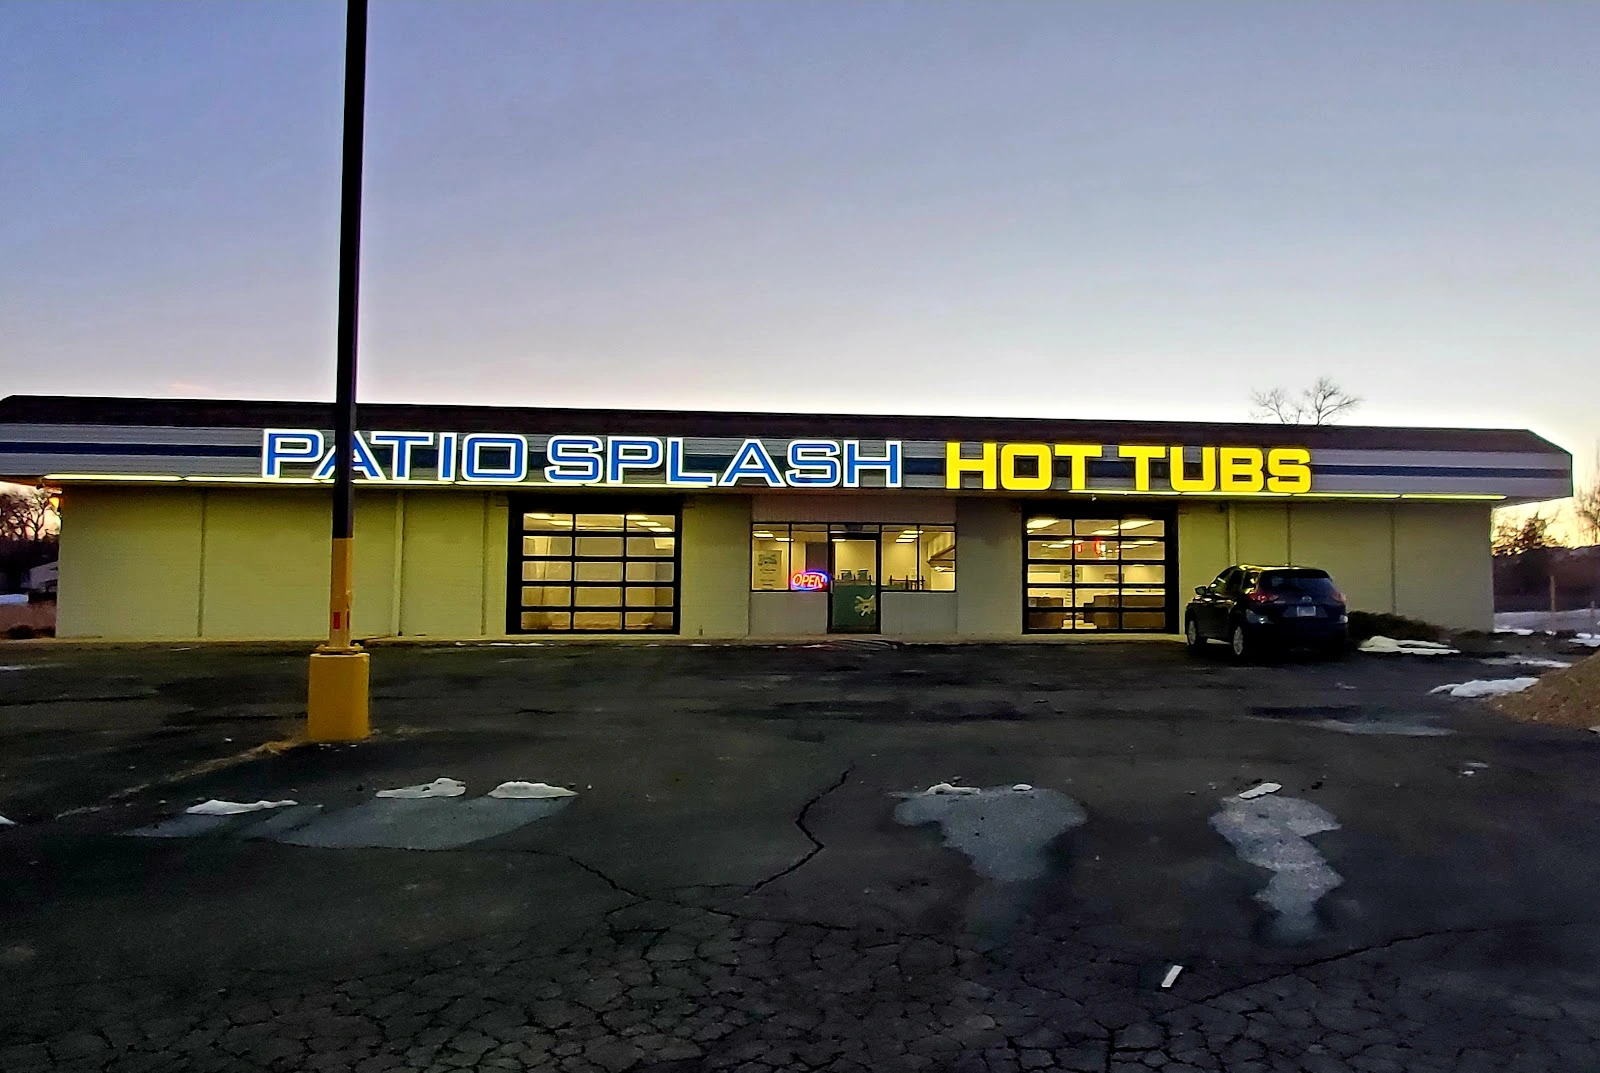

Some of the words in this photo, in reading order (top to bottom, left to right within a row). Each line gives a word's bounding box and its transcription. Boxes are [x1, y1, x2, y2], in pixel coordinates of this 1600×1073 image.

[262, 428, 528, 482] PATIO
[544, 435, 902, 488] SPLASH
[945, 442, 1103, 490] HOT
[1118, 445, 1312, 493] TUBS
[792, 573, 823, 588] OPEN
